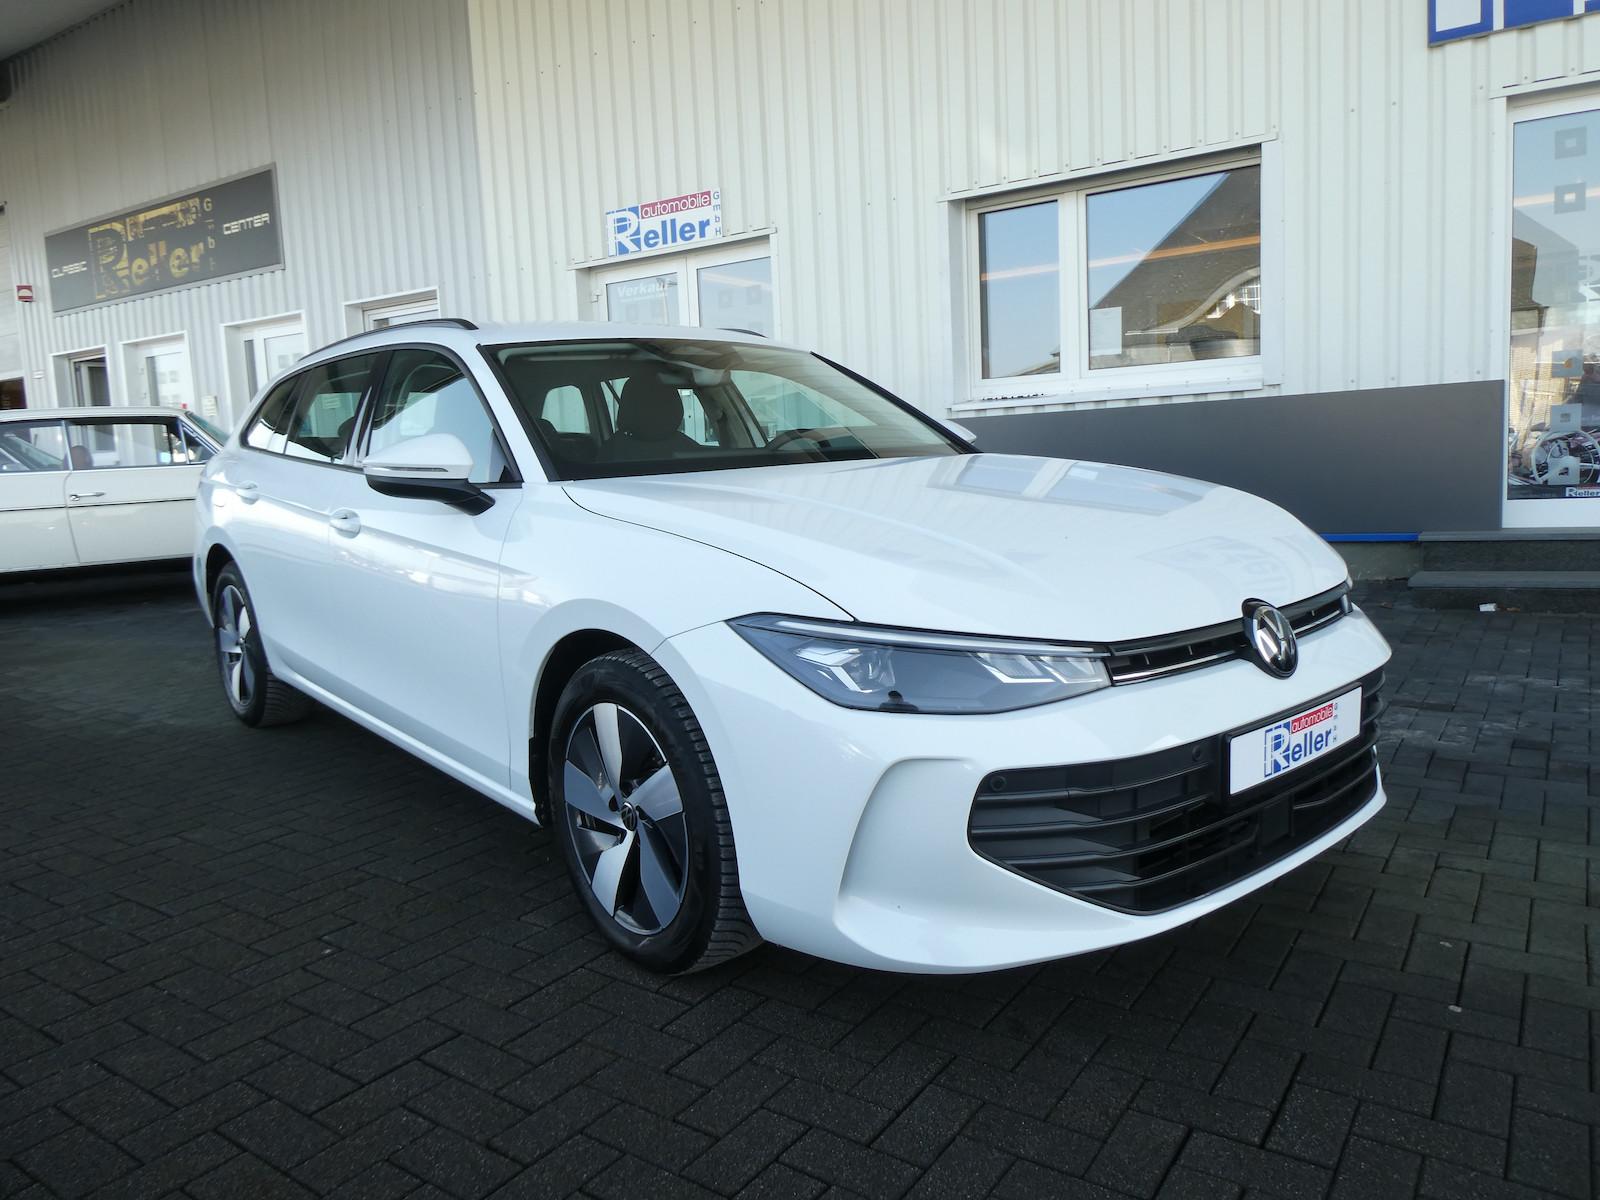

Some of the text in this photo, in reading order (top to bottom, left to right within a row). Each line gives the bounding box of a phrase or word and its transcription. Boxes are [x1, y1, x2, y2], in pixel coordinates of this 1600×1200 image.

[642, 193, 710, 218] automobile
[223, 212, 271, 235] CENTER
[606, 207, 711, 256] Reller
[1292, 705, 1333, 733] automobile
[1264, 722, 1331, 777] Reller
